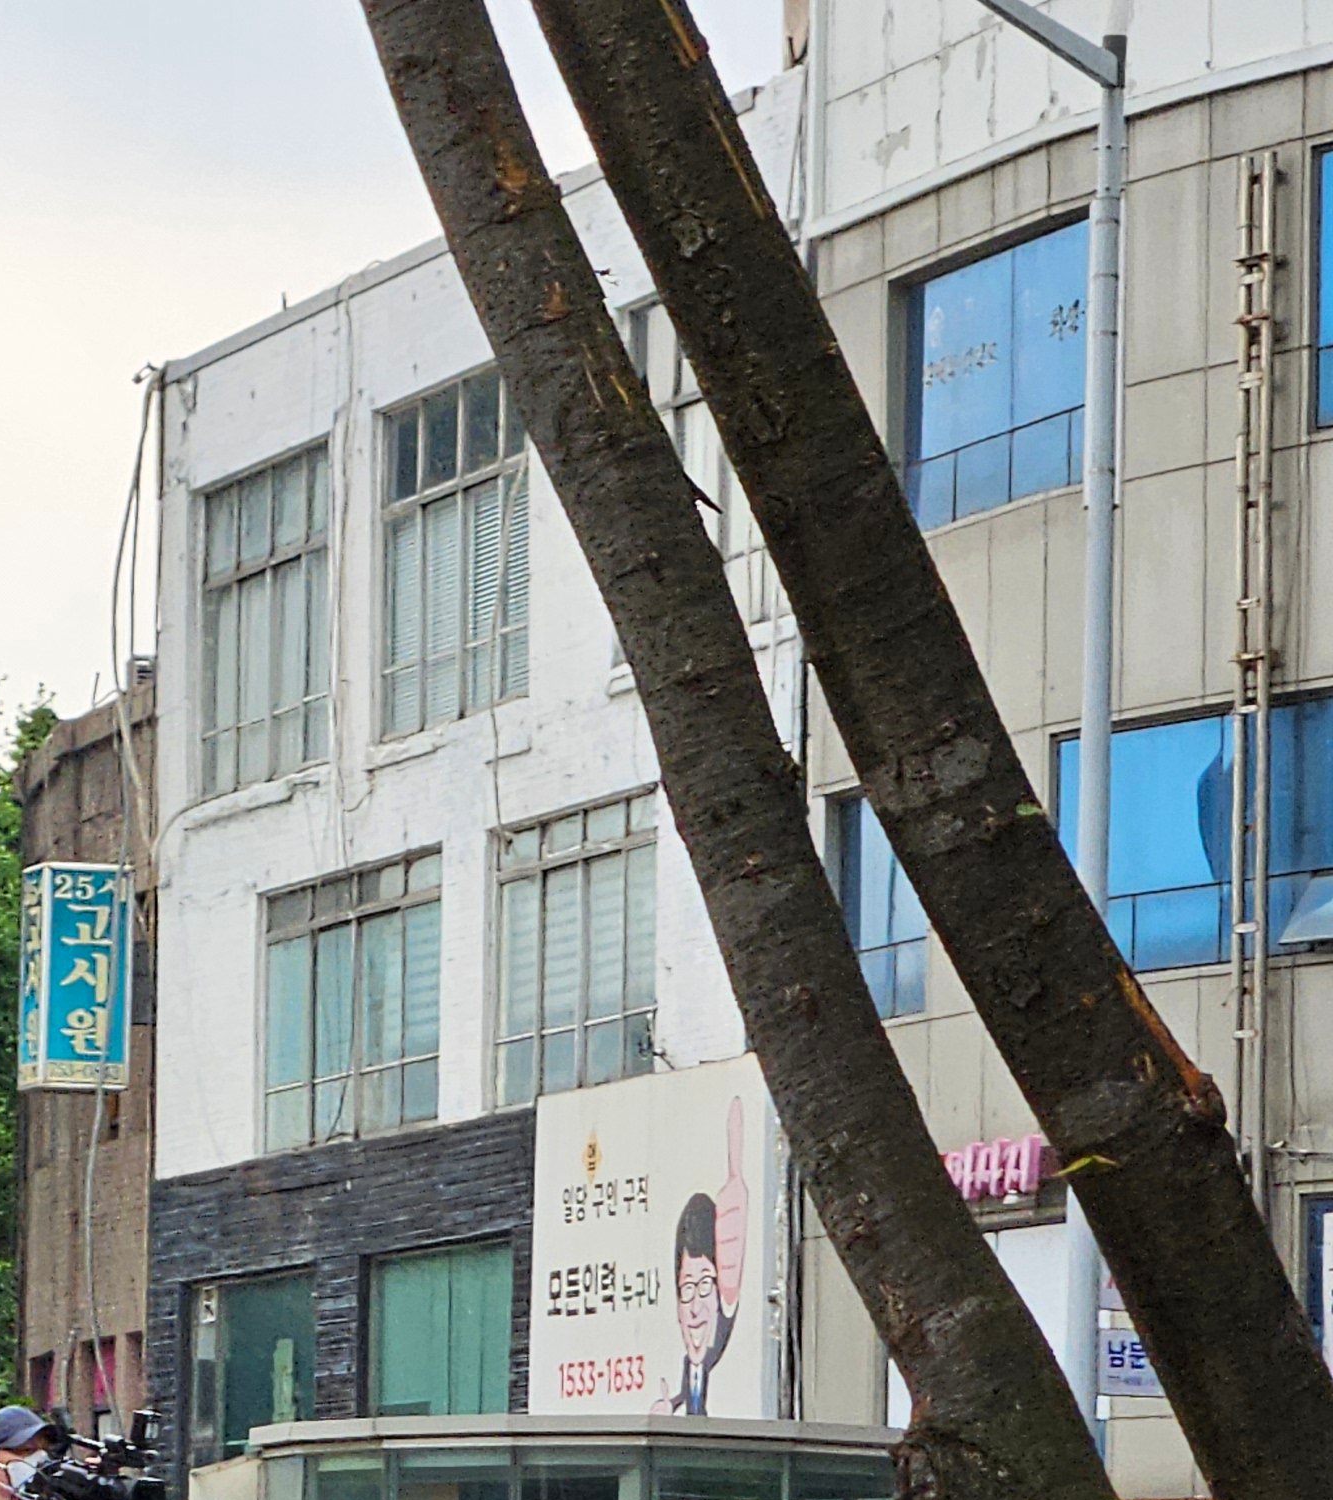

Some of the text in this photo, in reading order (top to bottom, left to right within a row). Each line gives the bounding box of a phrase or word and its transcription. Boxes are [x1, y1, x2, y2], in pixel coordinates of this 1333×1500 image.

[53, 873, 127, 903] 25시
[59, 903, 113, 1057] 고시원
[563, 1173, 649, 1224] 일당 구인 구직
[547, 1260, 661, 1317] 모든인력 누구나
[559, 1354, 645, 1398] 1533-1633
